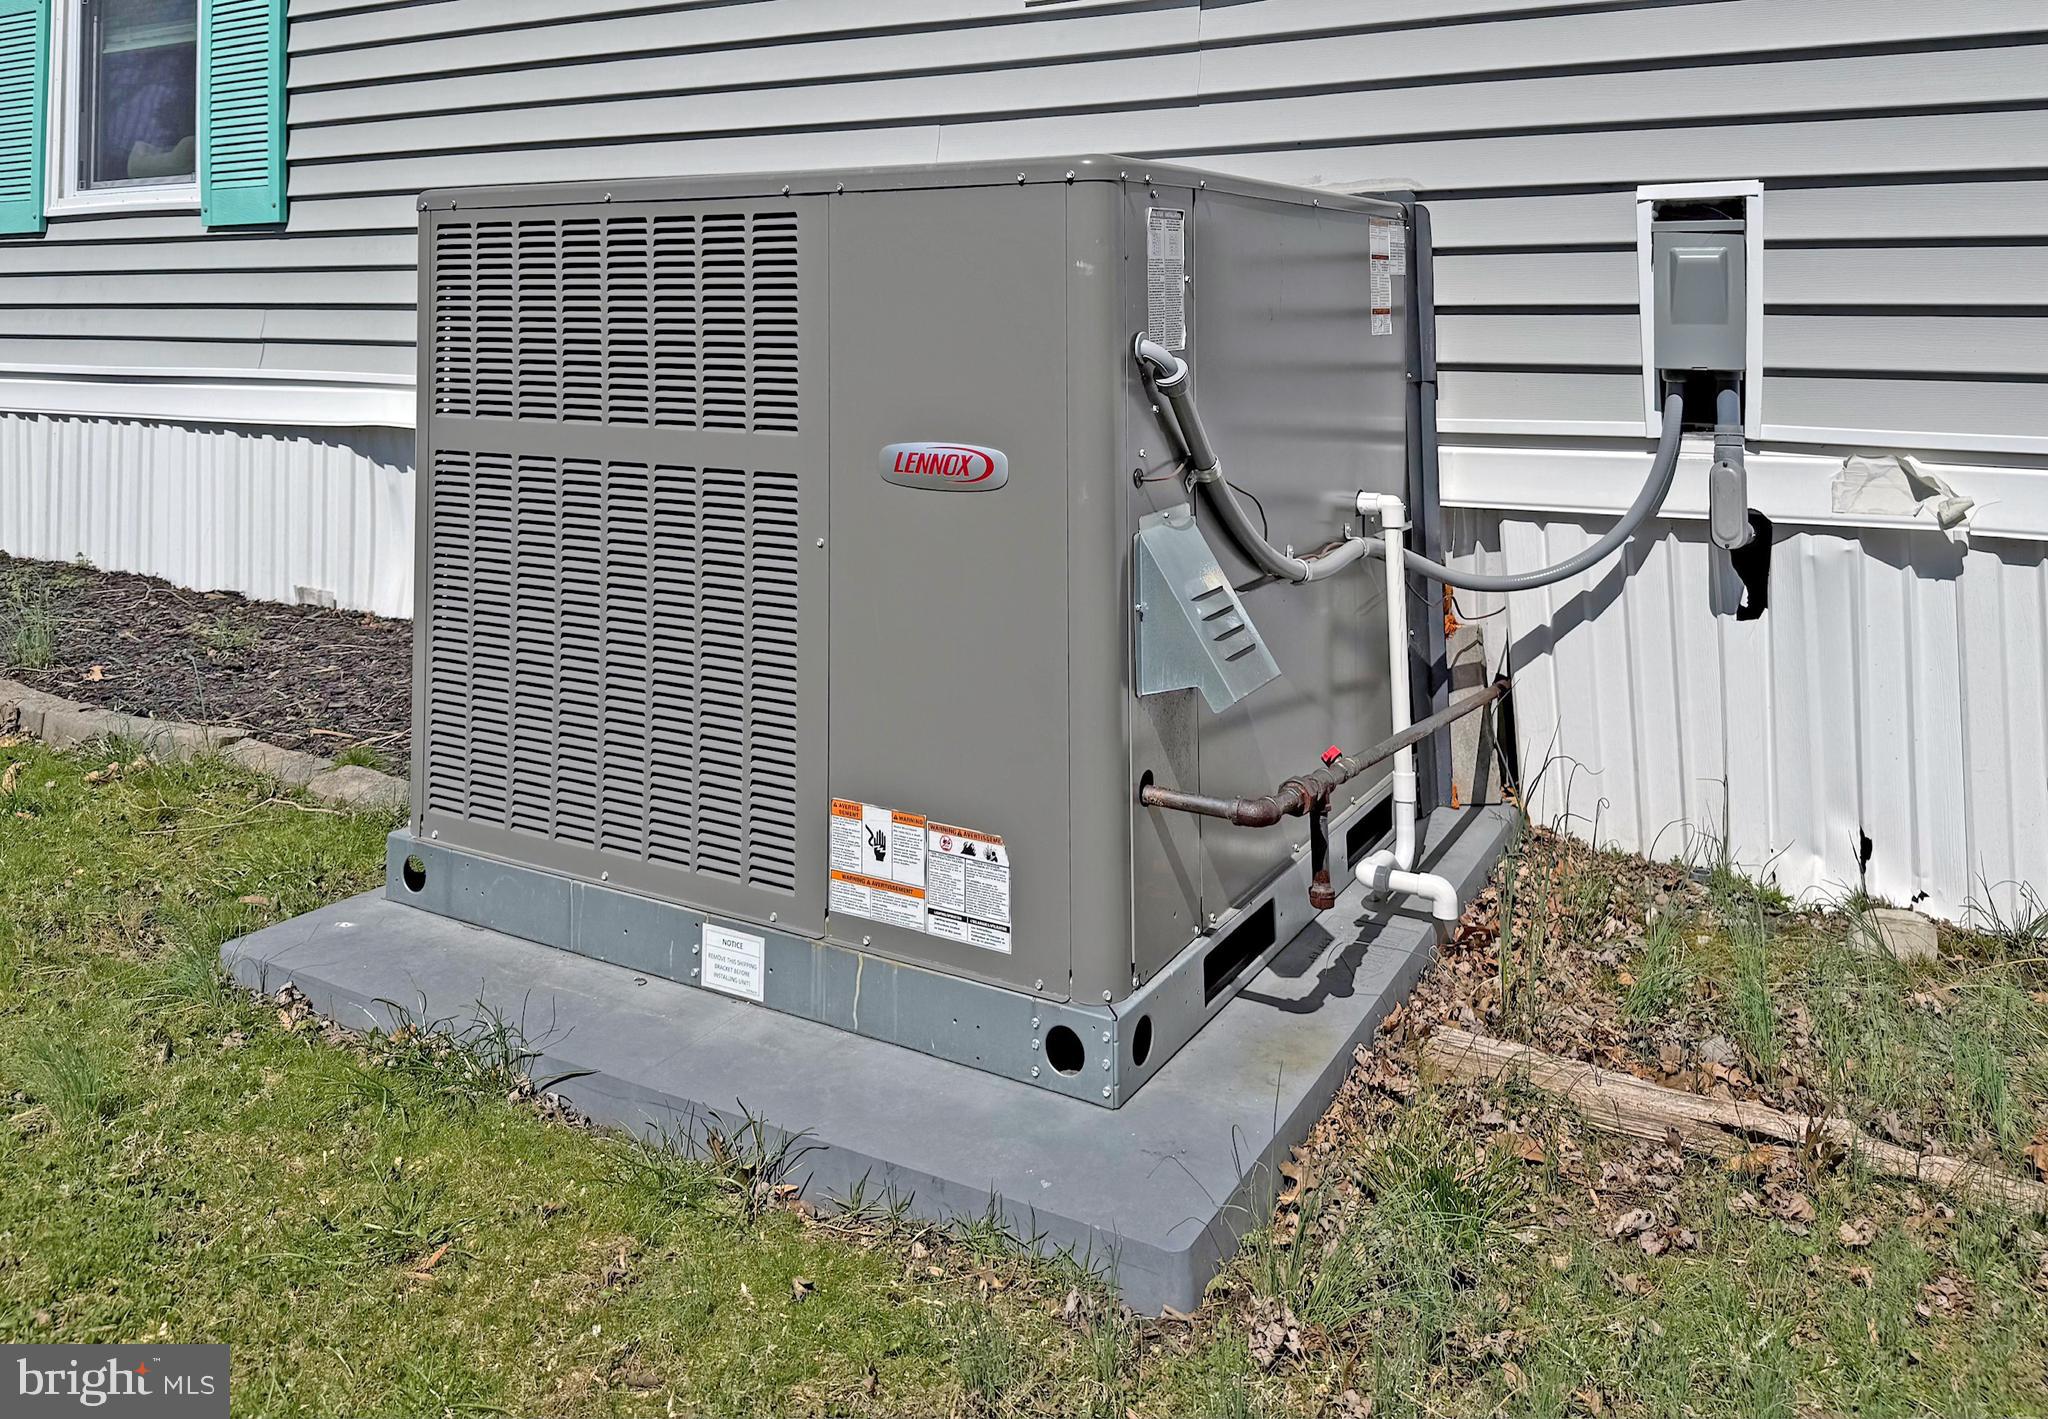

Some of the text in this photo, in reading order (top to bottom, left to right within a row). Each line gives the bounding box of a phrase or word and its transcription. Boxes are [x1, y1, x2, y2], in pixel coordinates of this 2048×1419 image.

[894, 451, 974, 477] LENNOX
[899, 815, 924, 825] WARNING
[929, 824, 957, 835] WARNING
[841, 873, 913, 895] WARNING AVERTISSEMENT
[722, 938, 743, 949] NOTICE
[708, 952, 726, 962] REMOVE
[714, 963, 733, 973] BRACKET
